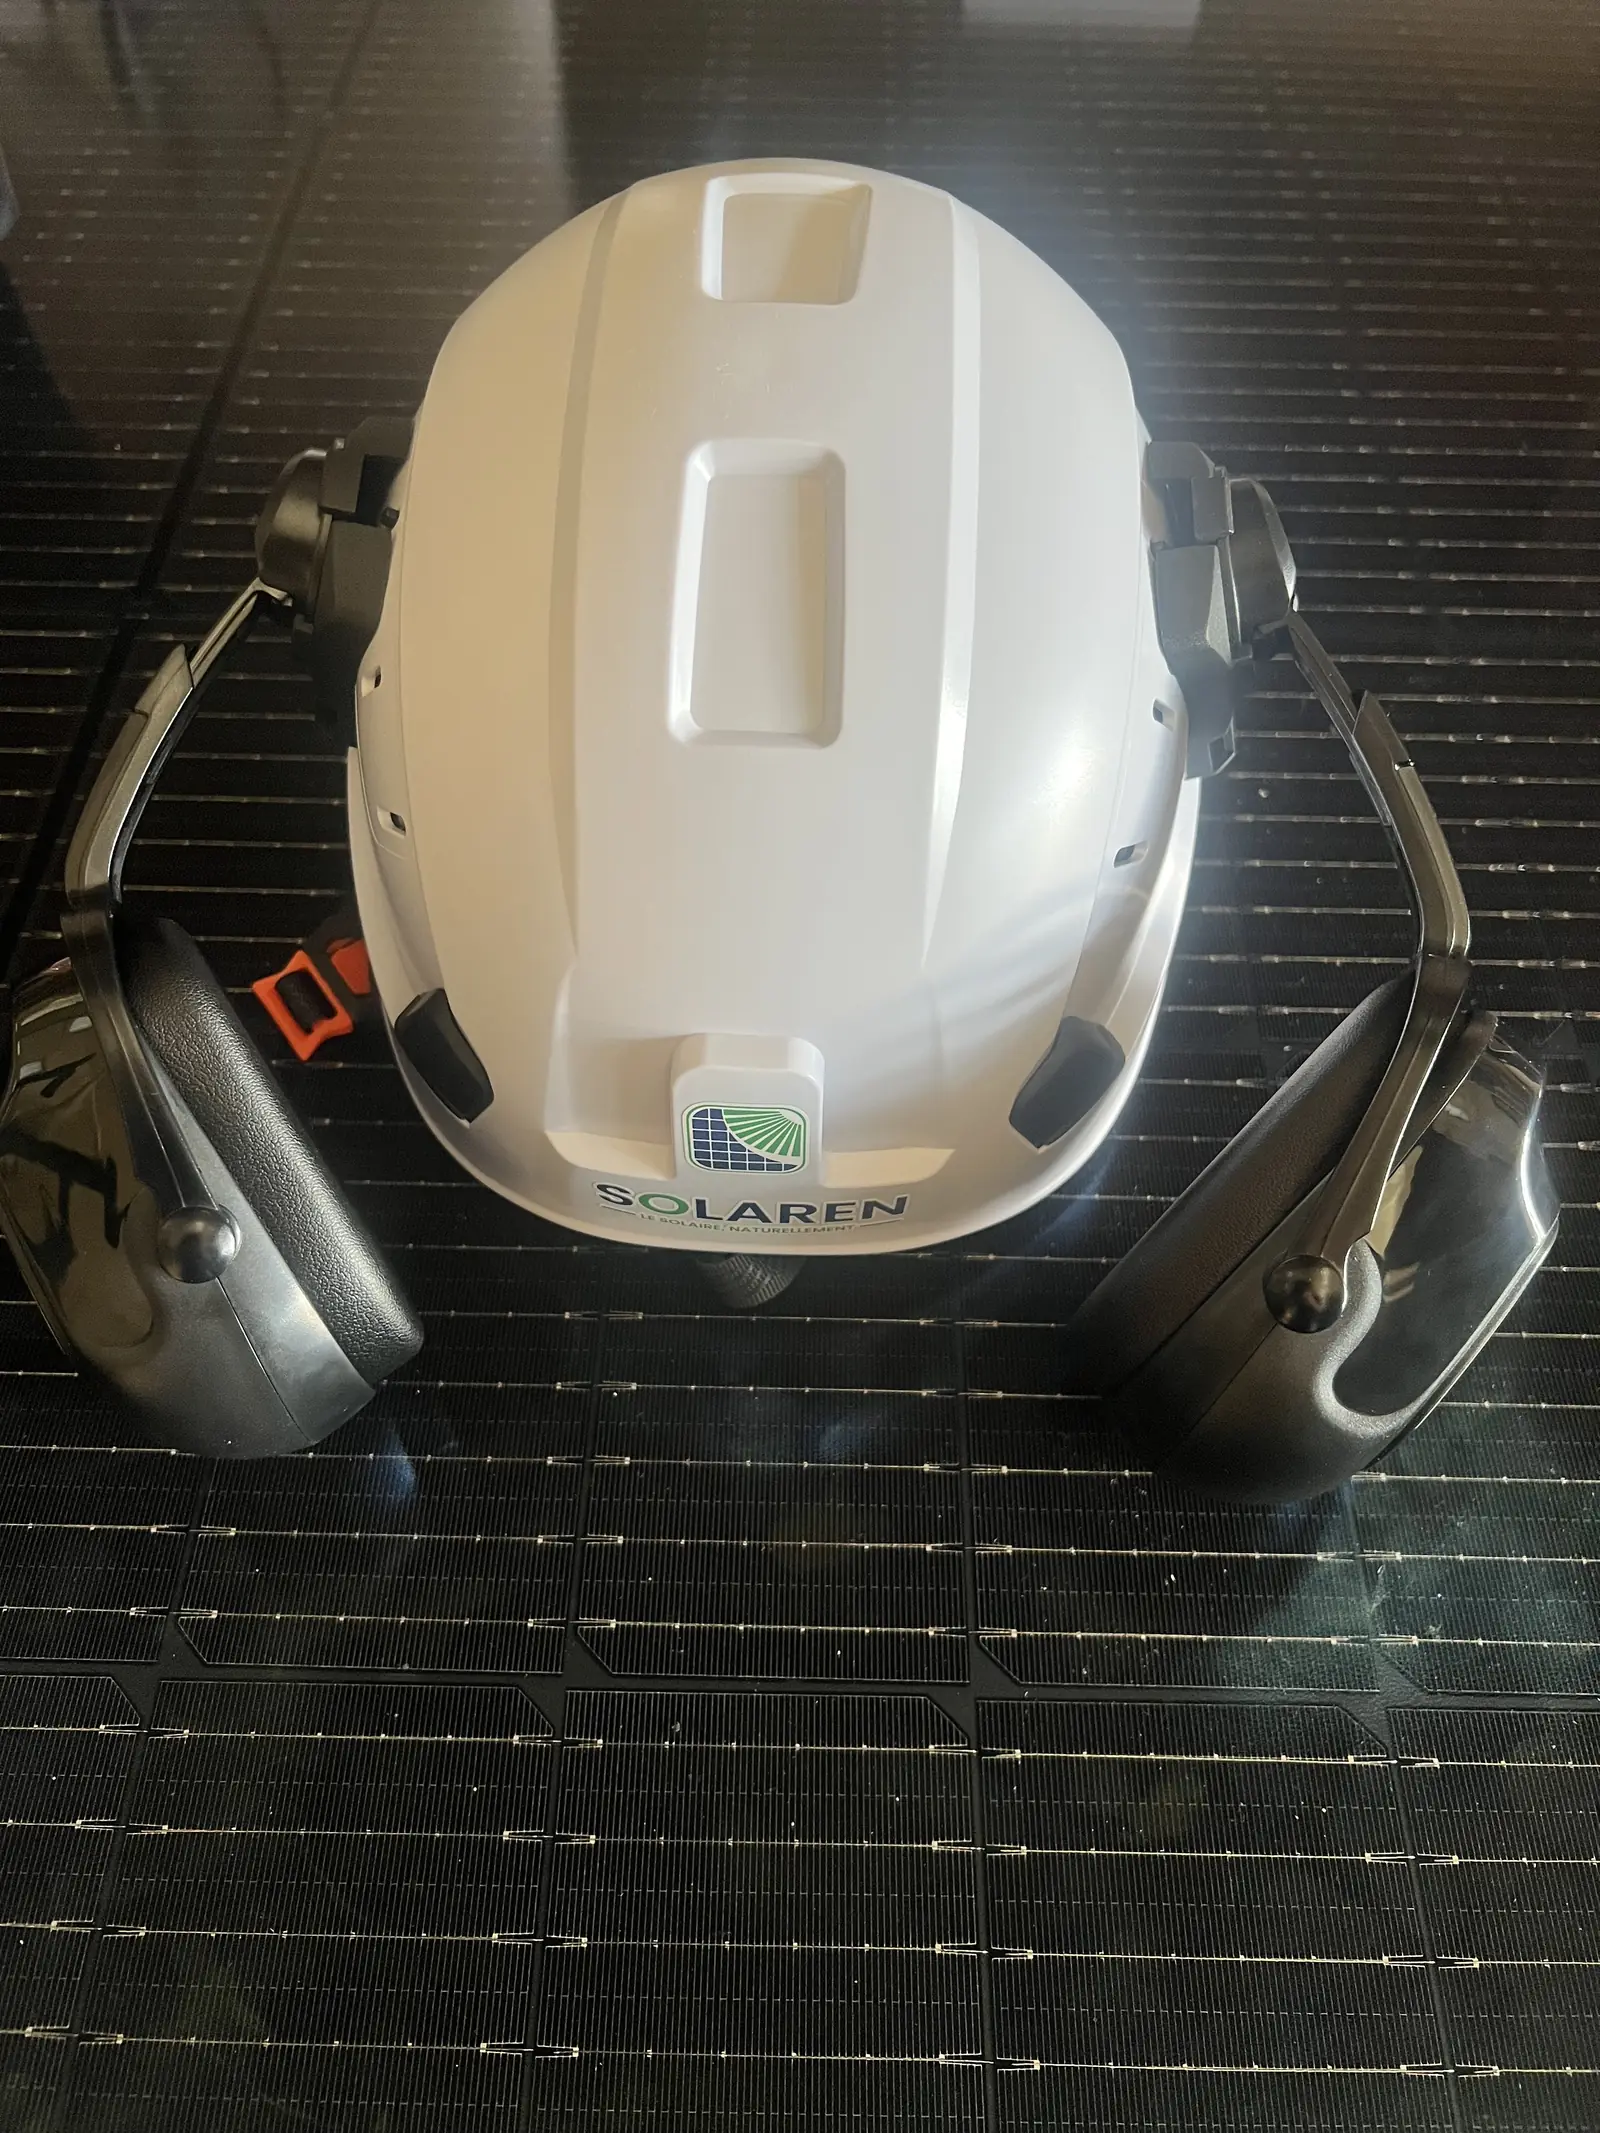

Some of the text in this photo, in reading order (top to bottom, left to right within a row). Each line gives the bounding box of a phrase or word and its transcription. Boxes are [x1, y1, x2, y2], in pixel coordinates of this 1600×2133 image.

[596, 1184, 908, 1224] SOLAREN
[640, 1214, 655, 1222] LE
[729, 1224, 857, 1234] NATURELLEMENT
